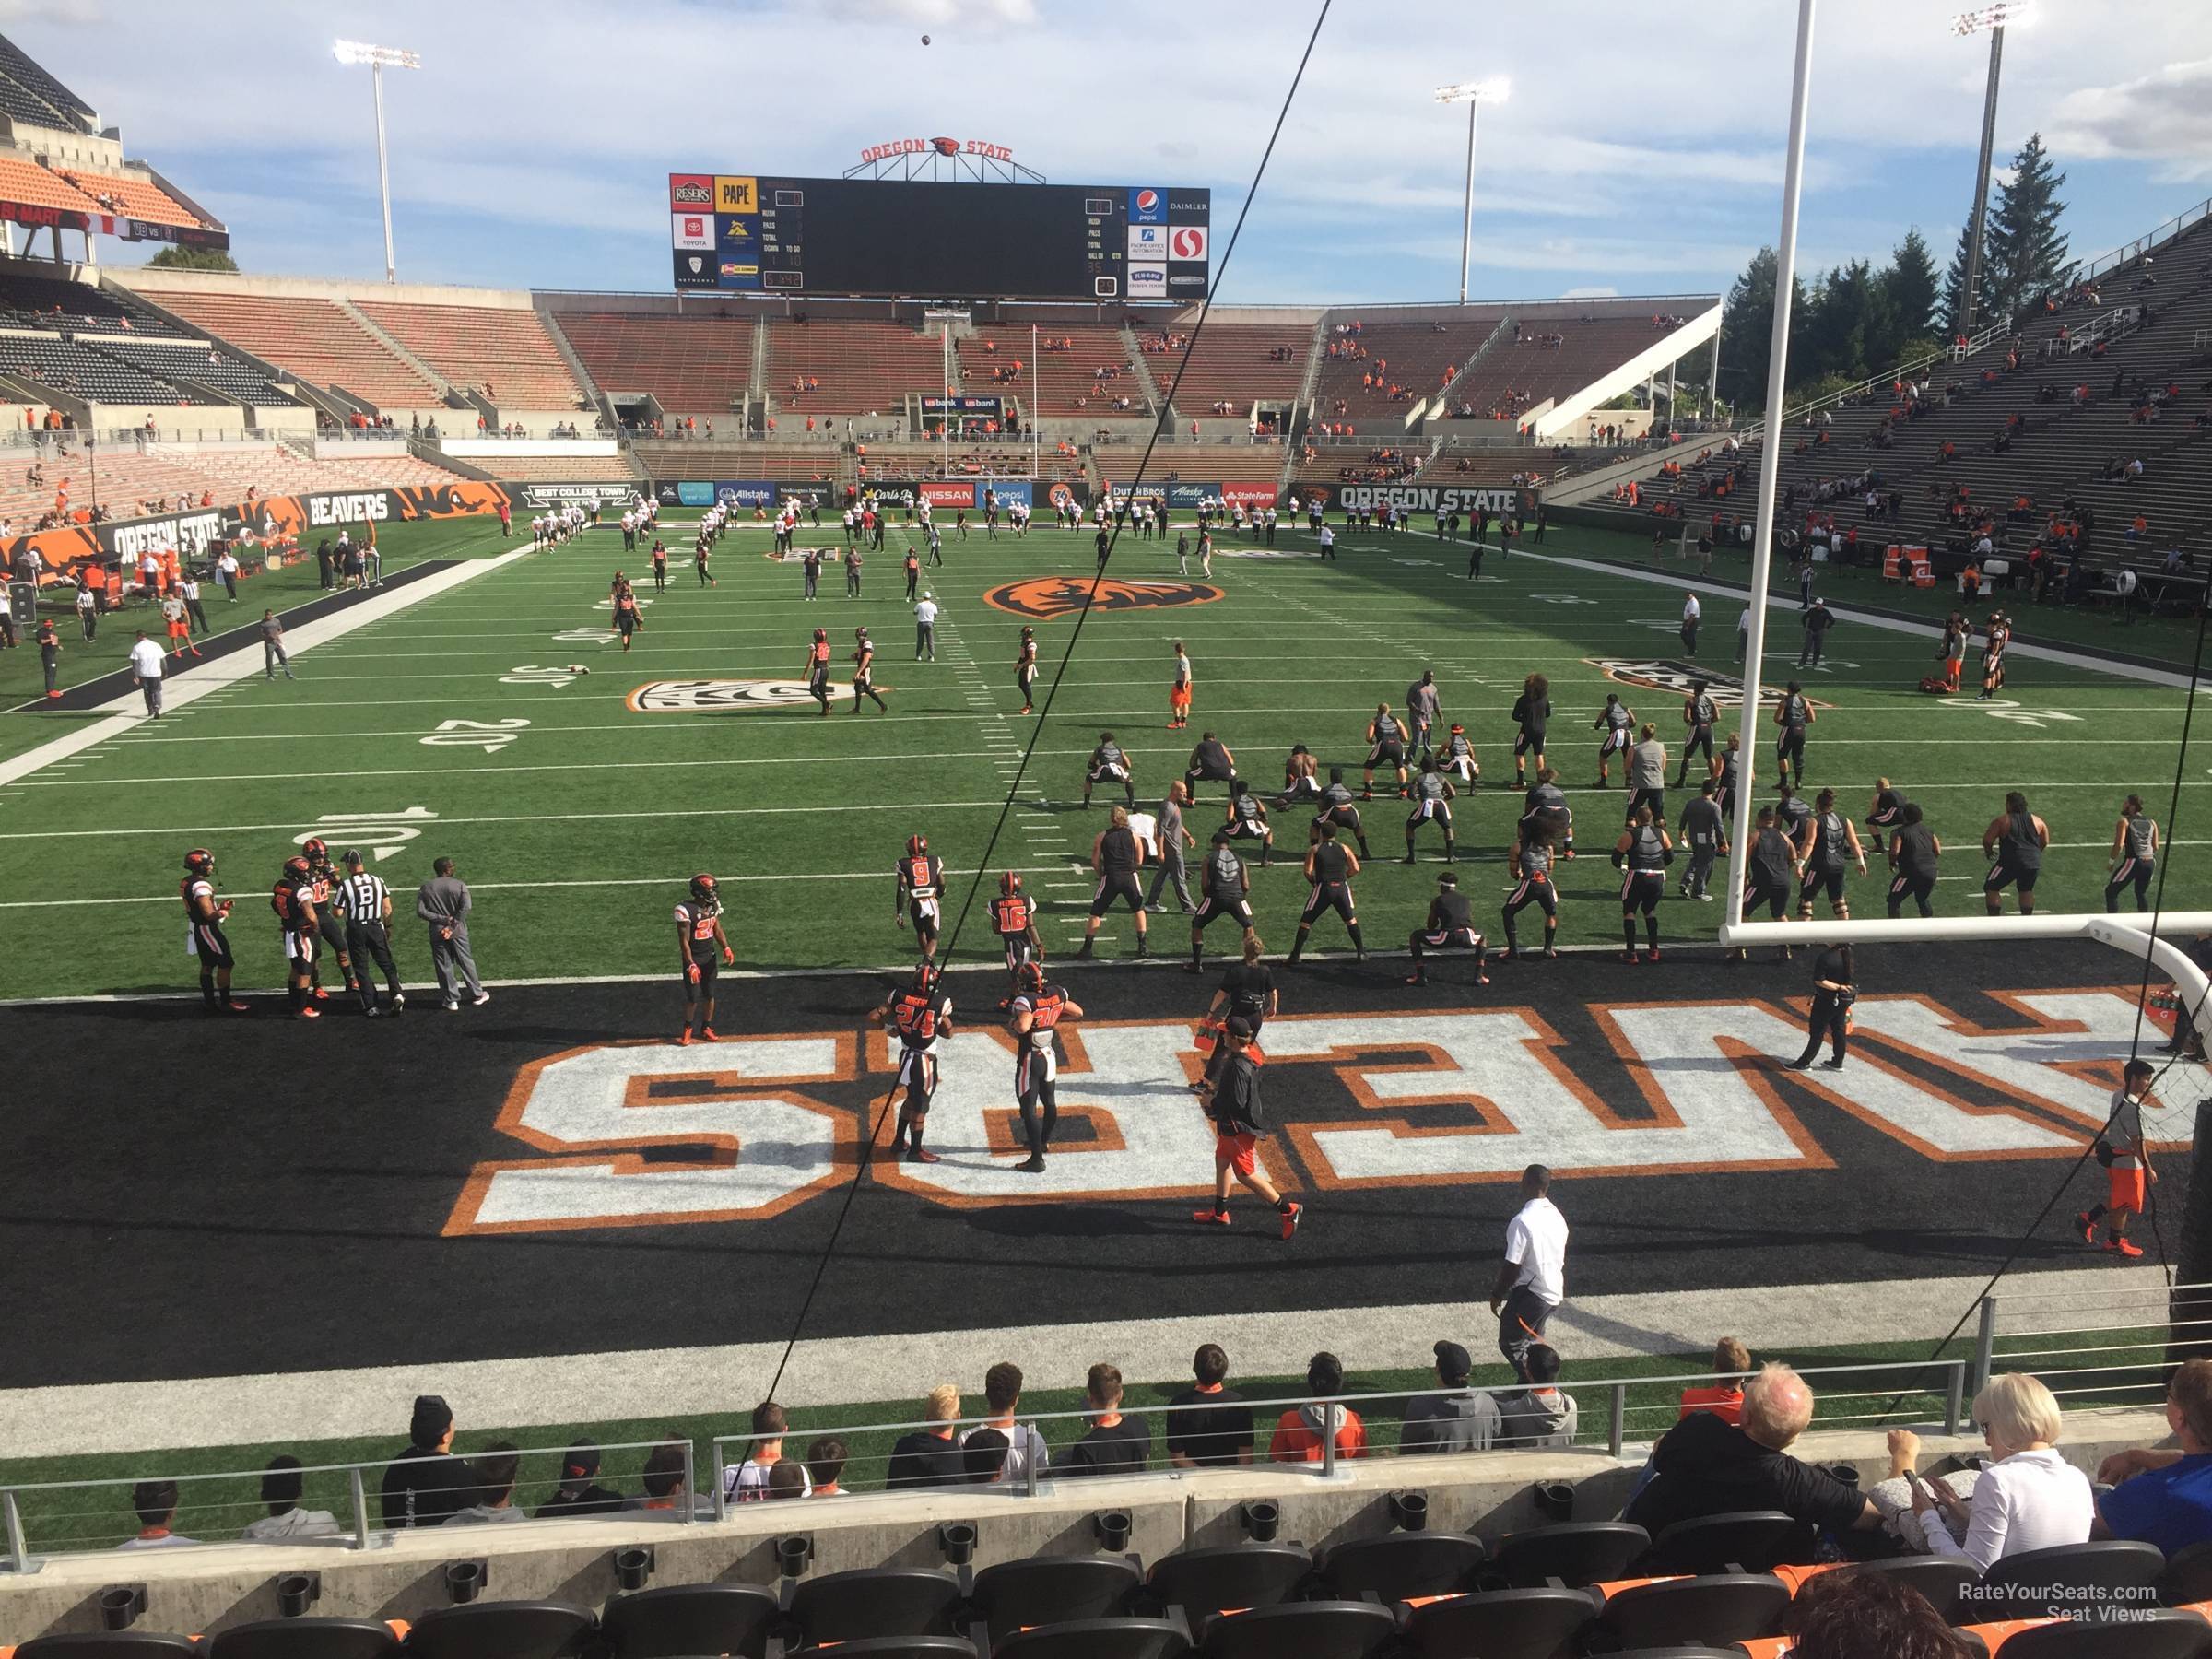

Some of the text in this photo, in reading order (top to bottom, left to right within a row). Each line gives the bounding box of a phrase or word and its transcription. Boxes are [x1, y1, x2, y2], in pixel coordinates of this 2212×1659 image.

[861, 139, 1013, 162] OREGON STATE
[1170, 203, 1208, 211] DAIMLER
[535, 488, 626, 497] BEST COLLEGE TOWN
[735, 489, 771, 500] Allstate
[923, 490, 972, 500] NISSAN
[996, 490, 1024, 501] pepsi
[1053, 490, 1068, 501] 76
[1172, 486, 1204, 496] Alaska
[1340, 487, 1517, 512] OREGON STATE
[310, 493, 389, 525] BEAVERS
[419, 718, 532, 747] 20
[292, 806, 440, 846] 10
[912, 861, 931, 887] 9
[360, 886, 373, 906] B
[999, 905, 1027, 932] 16
[895, 1003, 935, 1039] 24
[1032, 1002, 1065, 1029] 30
